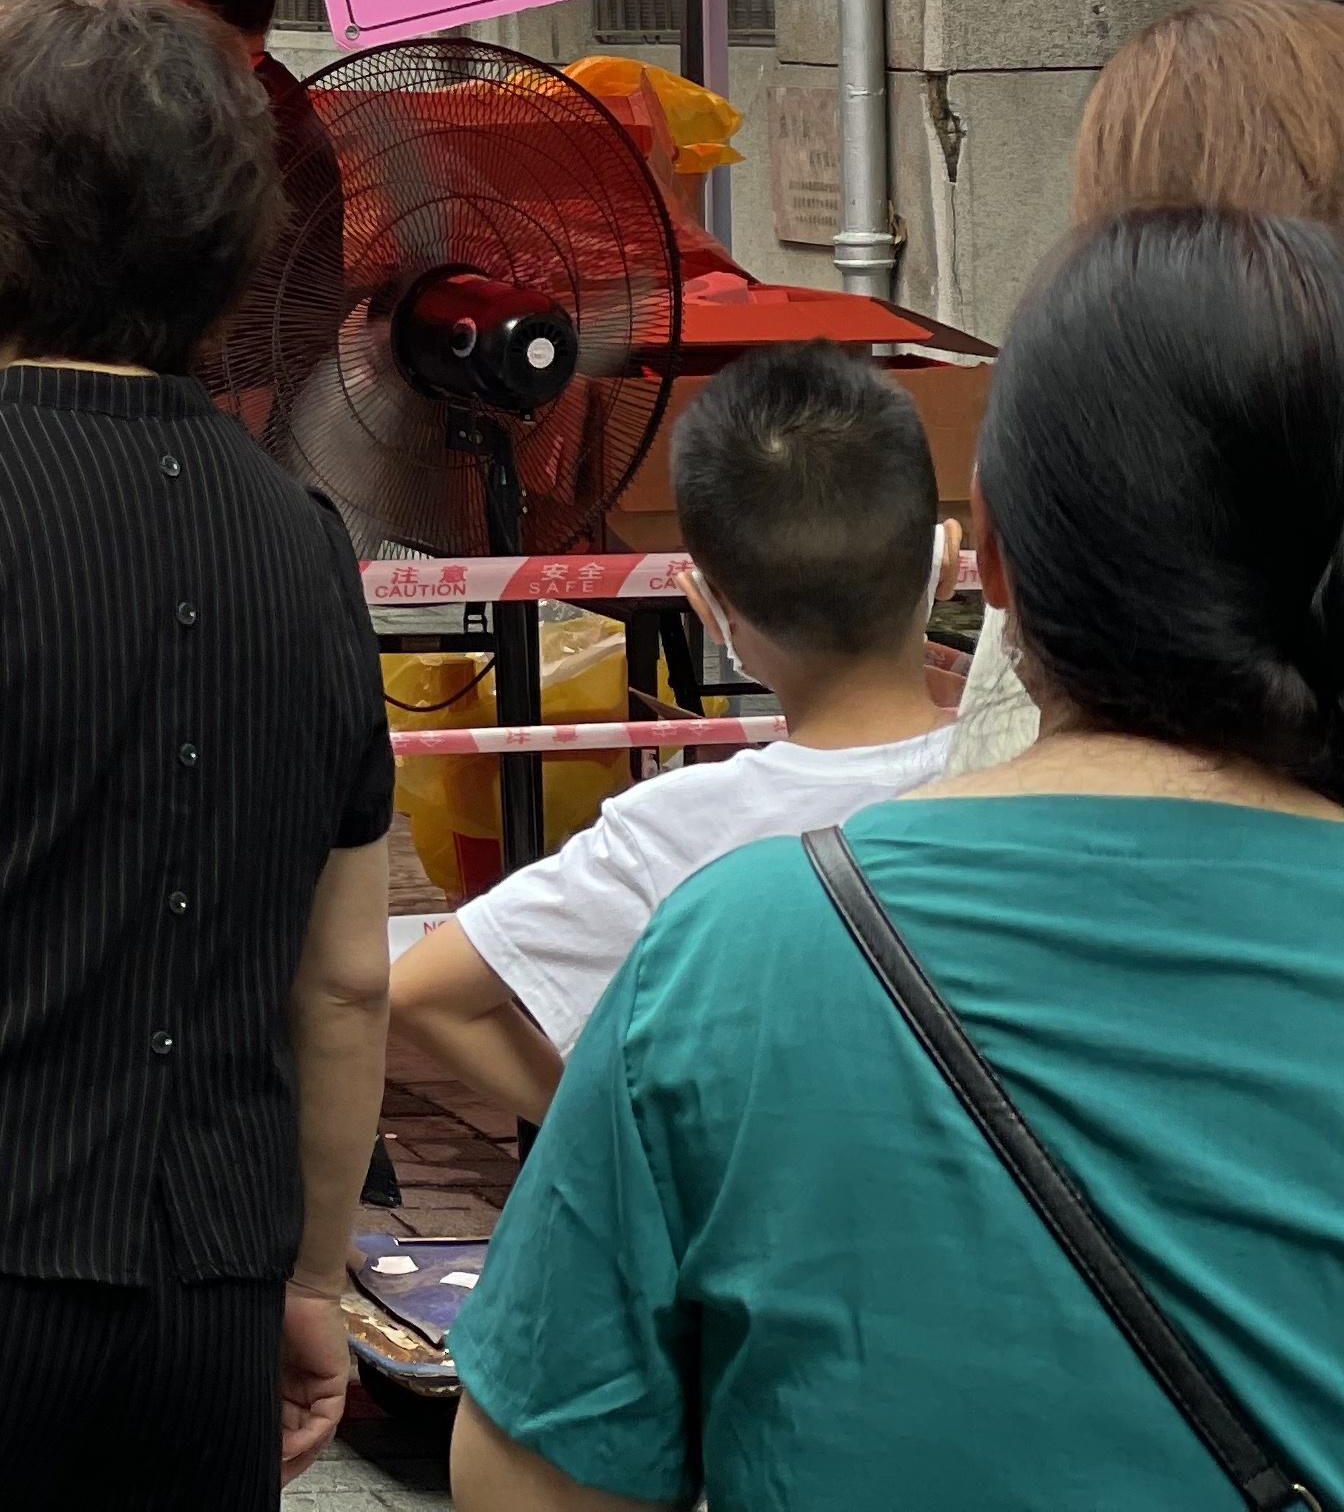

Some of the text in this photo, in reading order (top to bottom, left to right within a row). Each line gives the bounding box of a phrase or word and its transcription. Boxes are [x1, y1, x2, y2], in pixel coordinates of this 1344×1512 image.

[390, 564, 469, 585] 注意
[540, 561, 605, 582] 安全
[374, 583, 467, 599] CAUTION
[528, 580, 594, 595] SAFE
